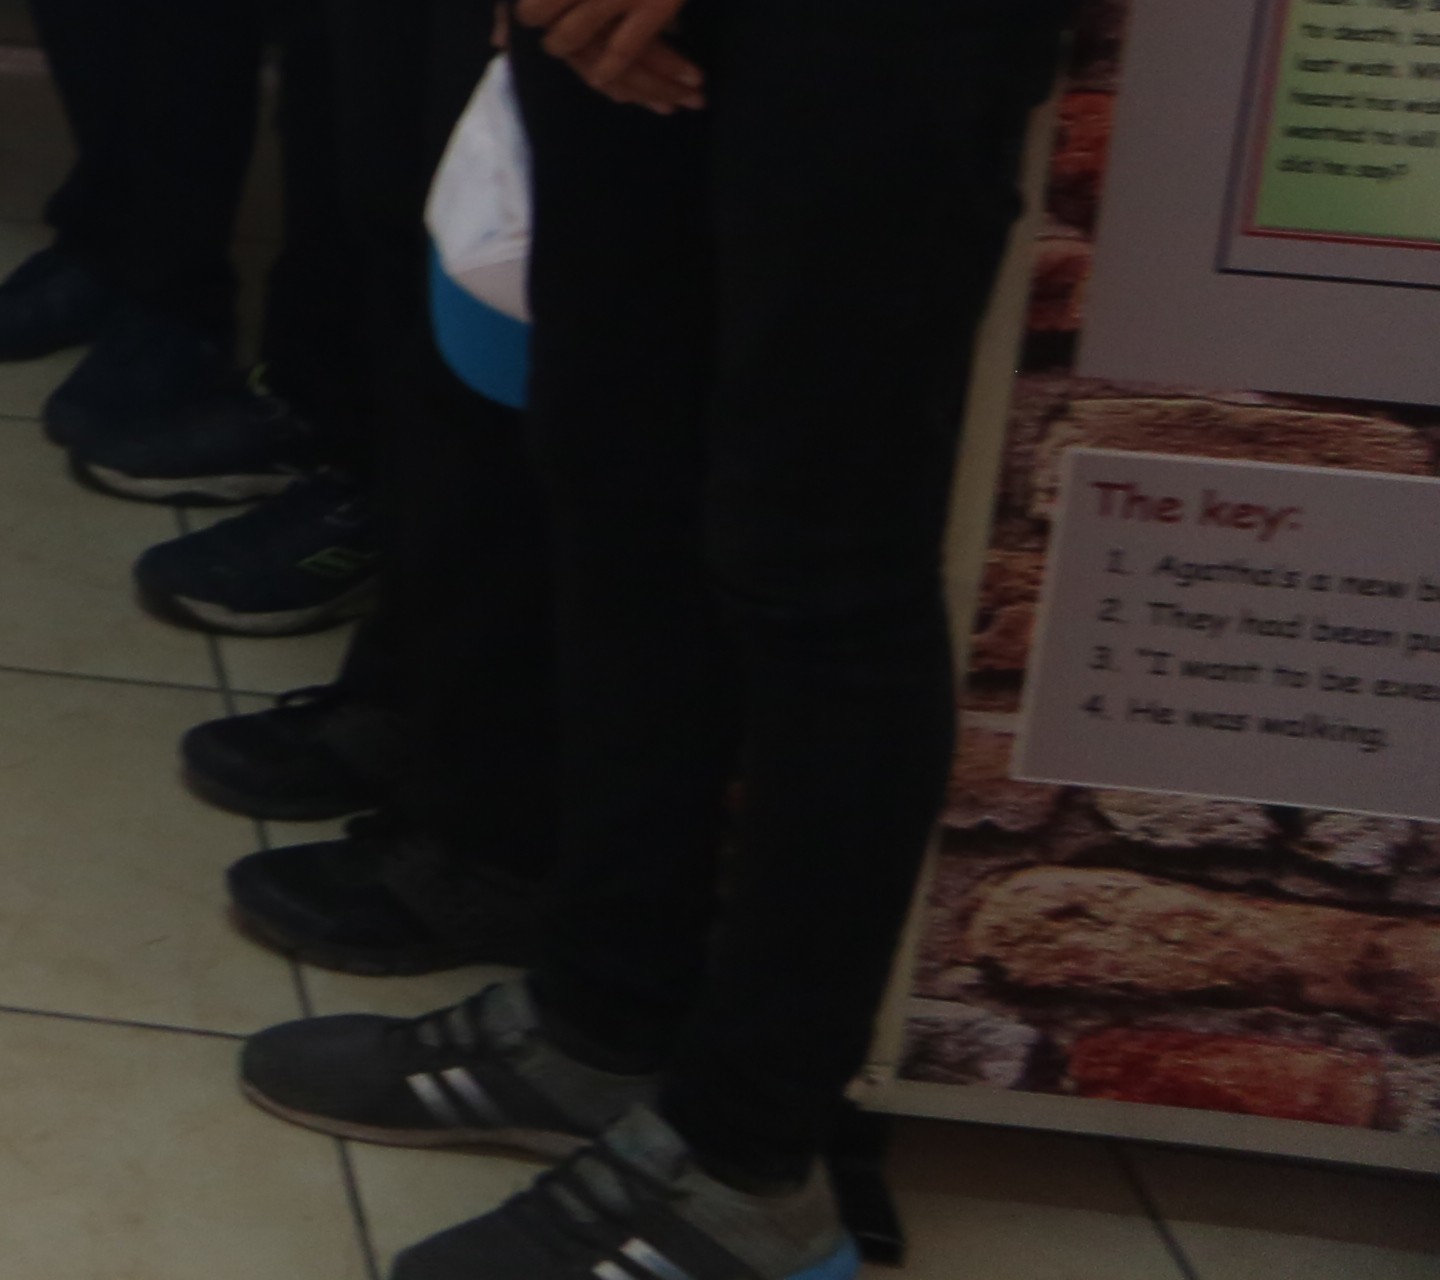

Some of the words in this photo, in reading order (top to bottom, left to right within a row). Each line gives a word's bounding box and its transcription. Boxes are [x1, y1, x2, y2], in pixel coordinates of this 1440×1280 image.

[1090, 480, 1183, 524] The
[1199, 488, 1305, 542] key:
[1152, 555, 1302, 589] Agatha's
[1308, 573, 1332, 591] a
[1340, 576, 1407, 599] new
[1146, 600, 1230, 639] They
[1239, 607, 1302, 639] had
[1312, 615, 1397, 647] been
[1181, 659, 1266, 685] want
[1272, 664, 1310, 690] to
[1318, 664, 1363, 694] be
[1127, 696, 1177, 726] He
[1183, 709, 1251, 733] was
